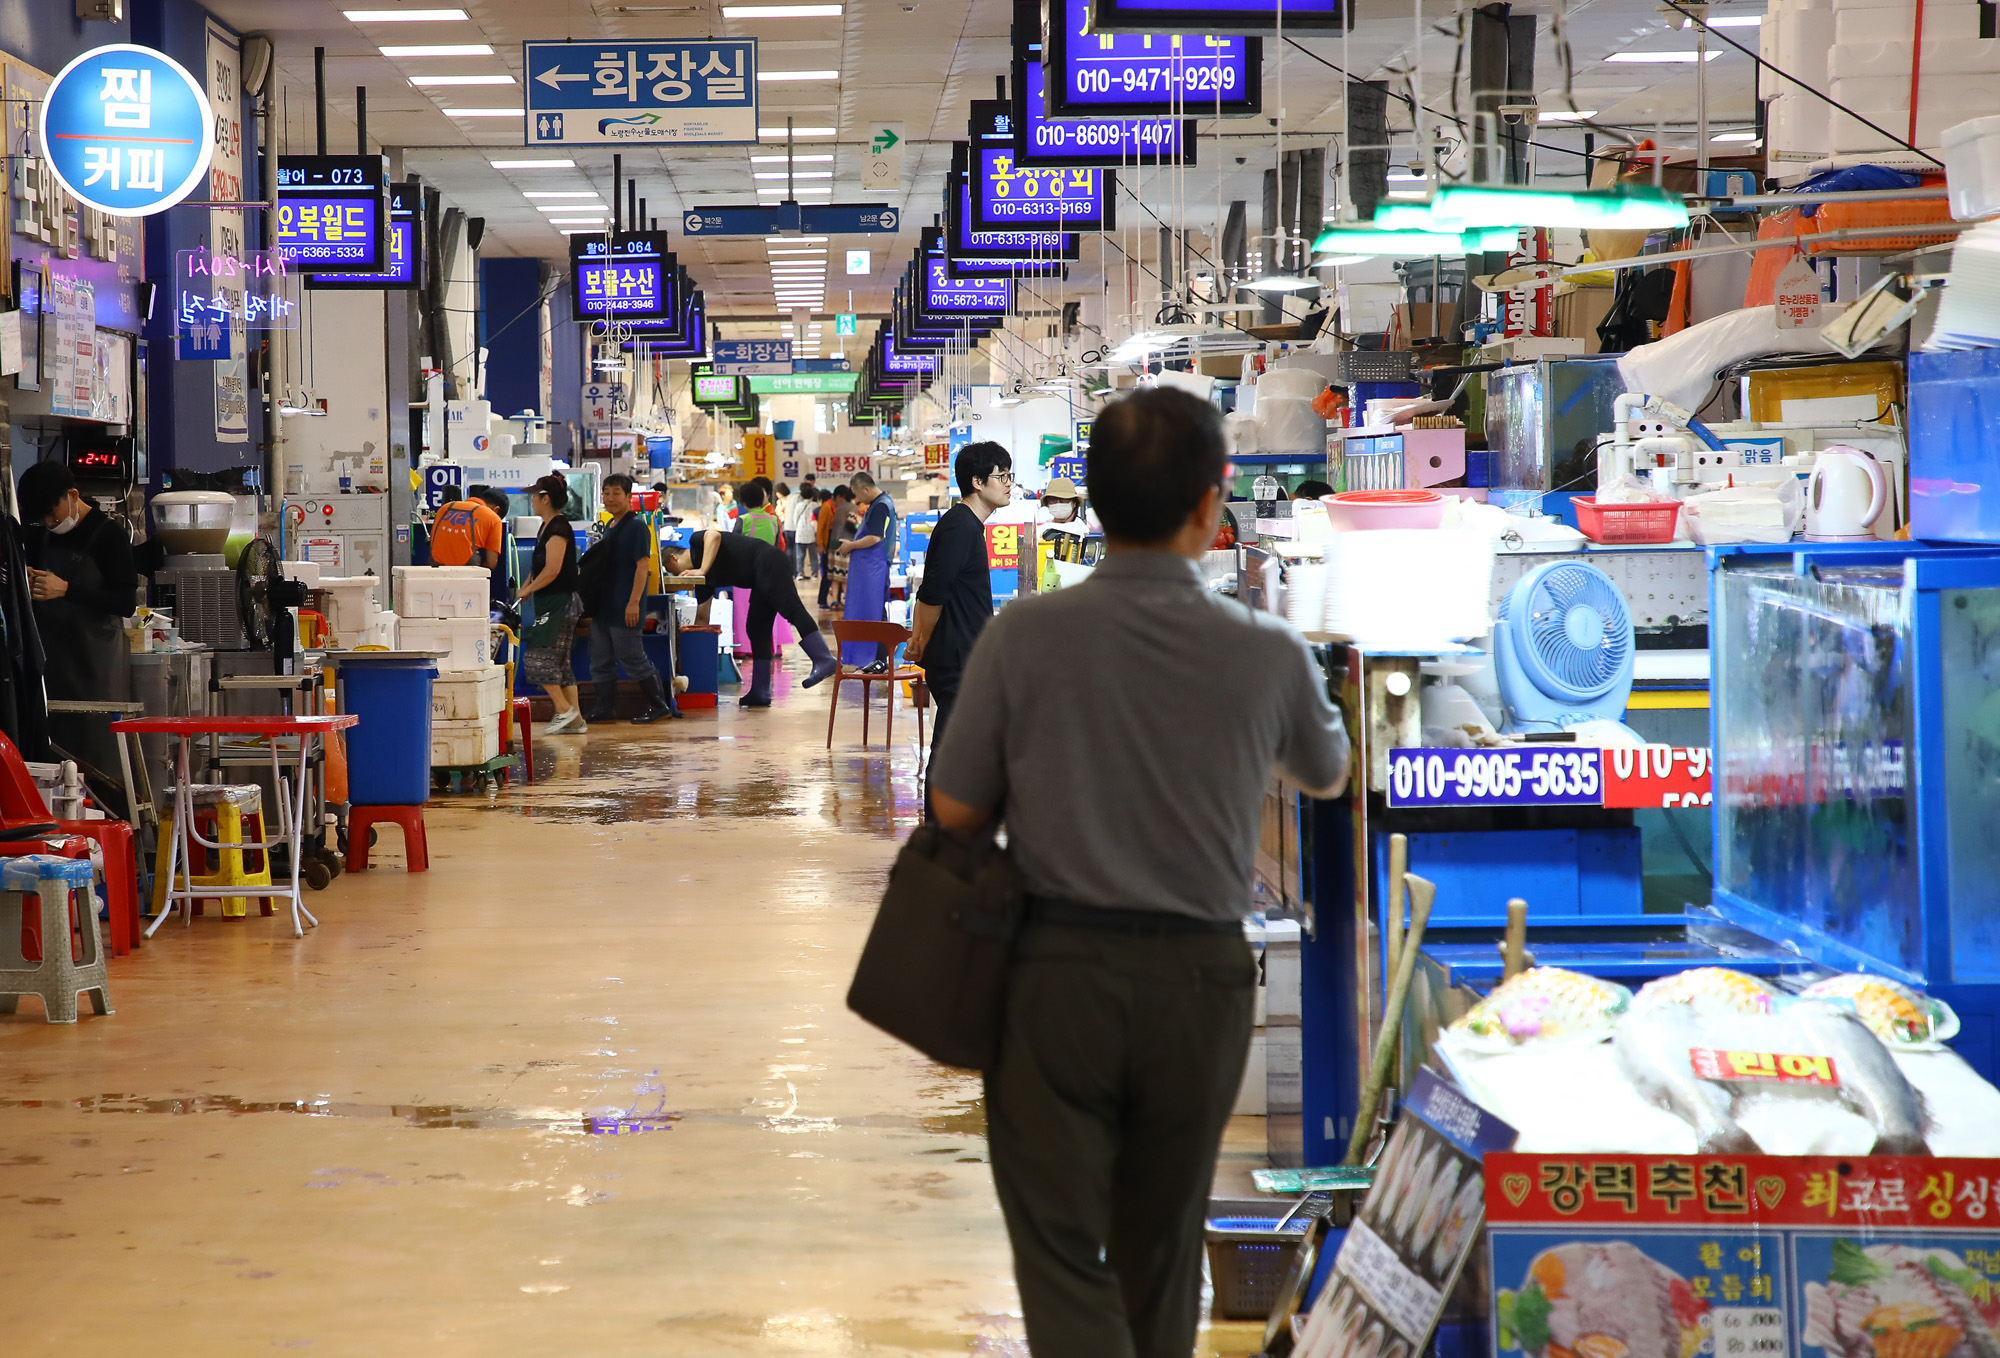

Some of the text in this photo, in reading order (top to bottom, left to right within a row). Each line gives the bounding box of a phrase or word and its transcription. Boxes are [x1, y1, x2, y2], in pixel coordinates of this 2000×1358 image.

[592, 49, 746, 102] 화장실
[1076, 66, 1236, 93] 010-9471-9299
[100, 68, 152, 129] 찜
[611, 128, 678, 138] 노량진수산물도매시장
[1036, 124, 1173, 146] 010-8609-1407
[83, 146, 164, 193] 커피
[277, 168, 305, 184] 활어
[331, 168, 363, 184] 073
[992, 202, 1092, 215] 010-6313-9169
[278, 204, 367, 241] 오복월드
[859, 214, 878, 223] 남2문
[627, 241, 652, 253] 064
[971, 233, 1059, 246] 010-6313-9169
[278, 246, 364, 258] 010-6366-5334
[585, 268, 655, 297] 보물수산
[587, 300, 654, 310] 010-2448-3946
[931, 294, 1006, 306] 010-5673-1473
[1779, 293, 1819, 306] 온누리상품권
[1789, 307, 1809, 318] 가맹점
[735, 343, 790, 361] 화장실
[754, 437, 767, 475] 아나고
[782, 441, 799, 478] 구일
[815, 456, 870, 472] 민물장어
[1744, 449, 1773, 464] 맑음
[489, 469, 521, 480] H-111
[1058, 462, 1084, 479] 진도
[1393, 752, 1600, 799] 010-9905-5635
[1613, 748, 1712, 780] 010-9
[1540, 1161, 1637, 1214] 강력
[1647, 1161, 1750, 1214] 추천
[1802, 1169, 1910, 1218] 최고로
